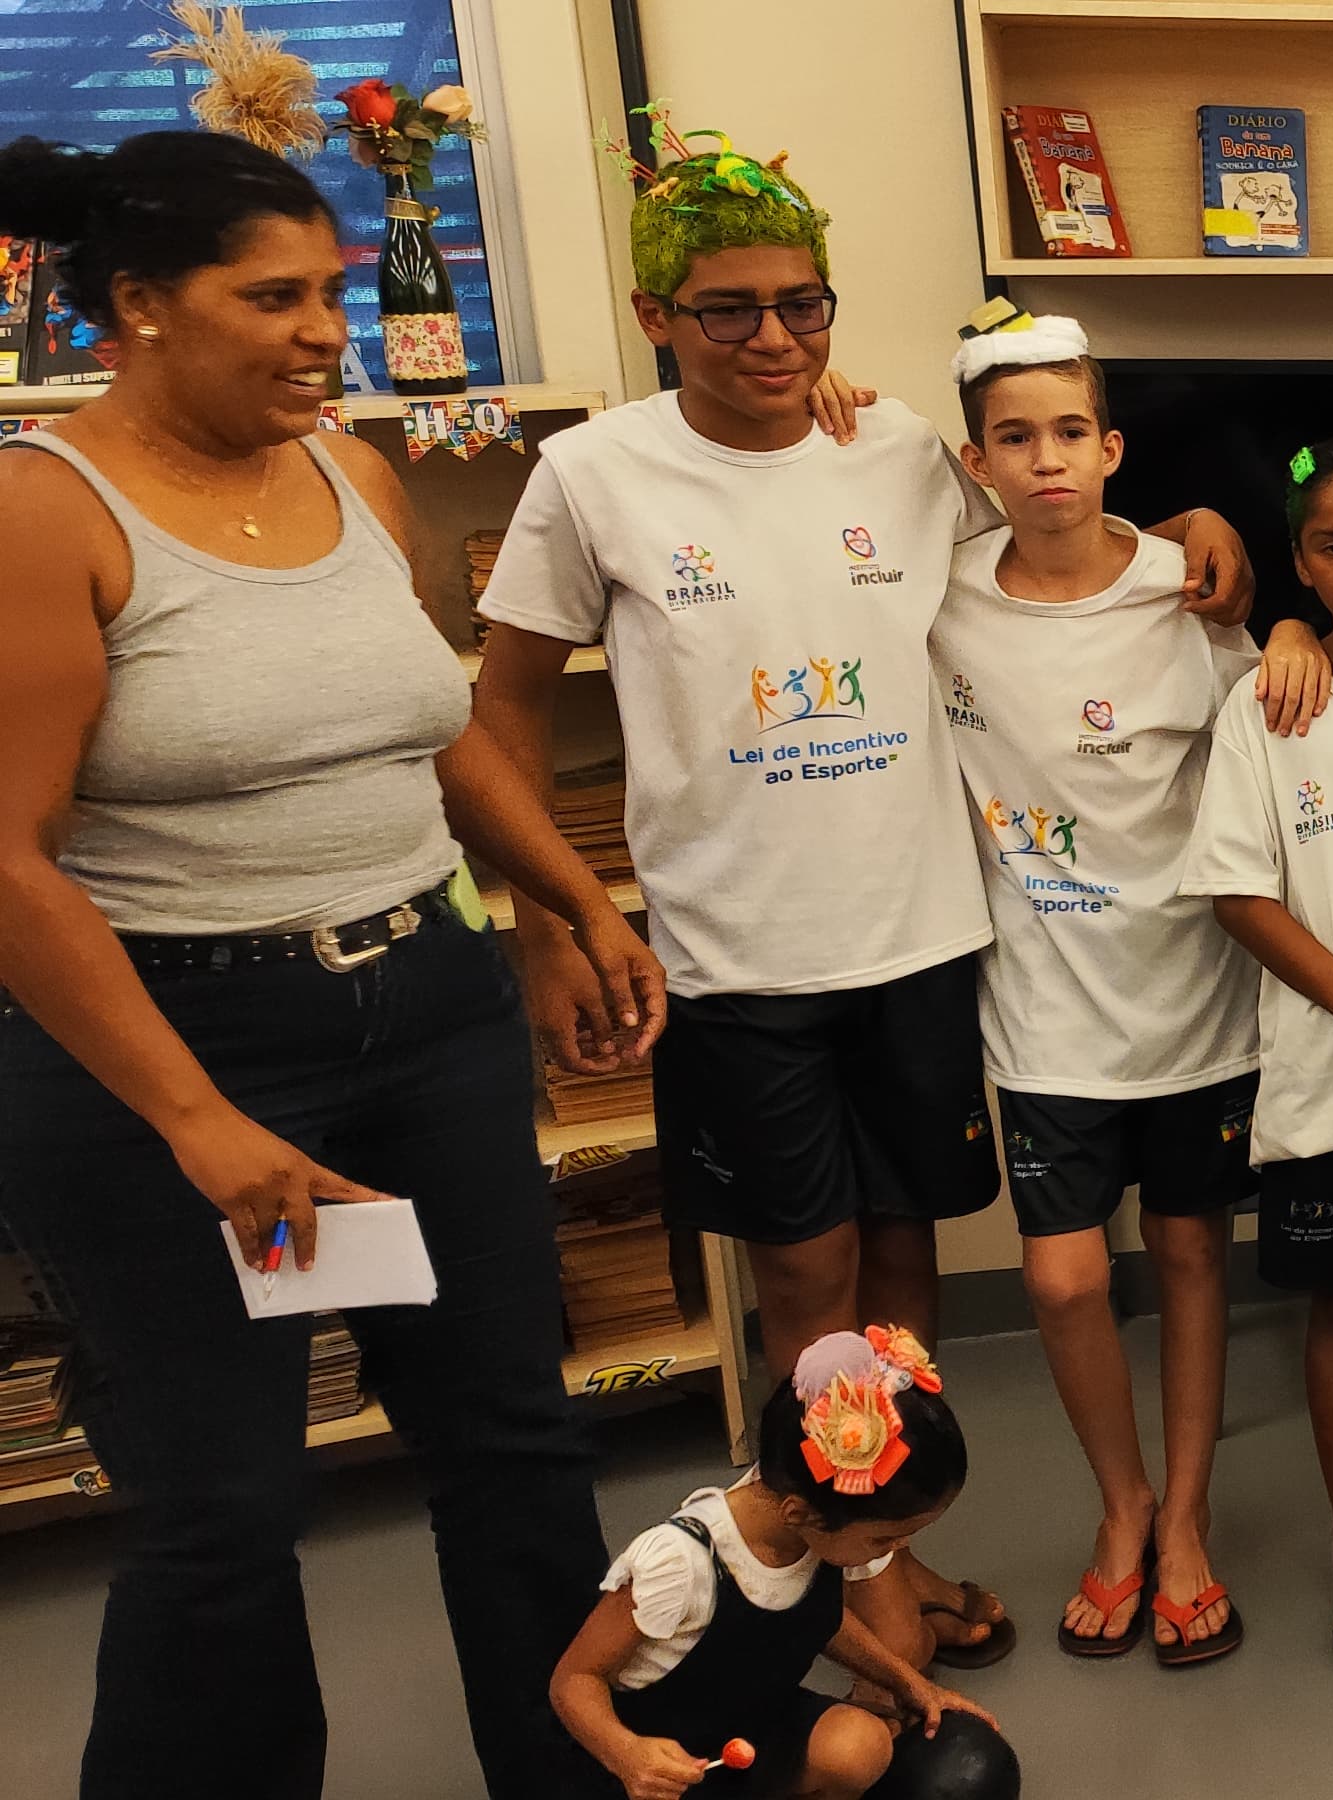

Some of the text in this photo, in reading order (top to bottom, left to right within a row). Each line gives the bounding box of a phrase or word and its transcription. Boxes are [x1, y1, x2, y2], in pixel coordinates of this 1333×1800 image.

[1228, 112, 1287, 128] DIÁRIO
[1040, 137, 1095, 161] Banana
[1220, 137, 1294, 160] Banana
[851, 569, 904, 586] incluir
[667, 581, 735, 601] BRASIL
[729, 731, 908, 764] Lei de Incentivo
[765, 755, 888, 785] ao Esporte
[1027, 895, 1102, 915] sporte
[588, 1359, 673, 1393] TEX
